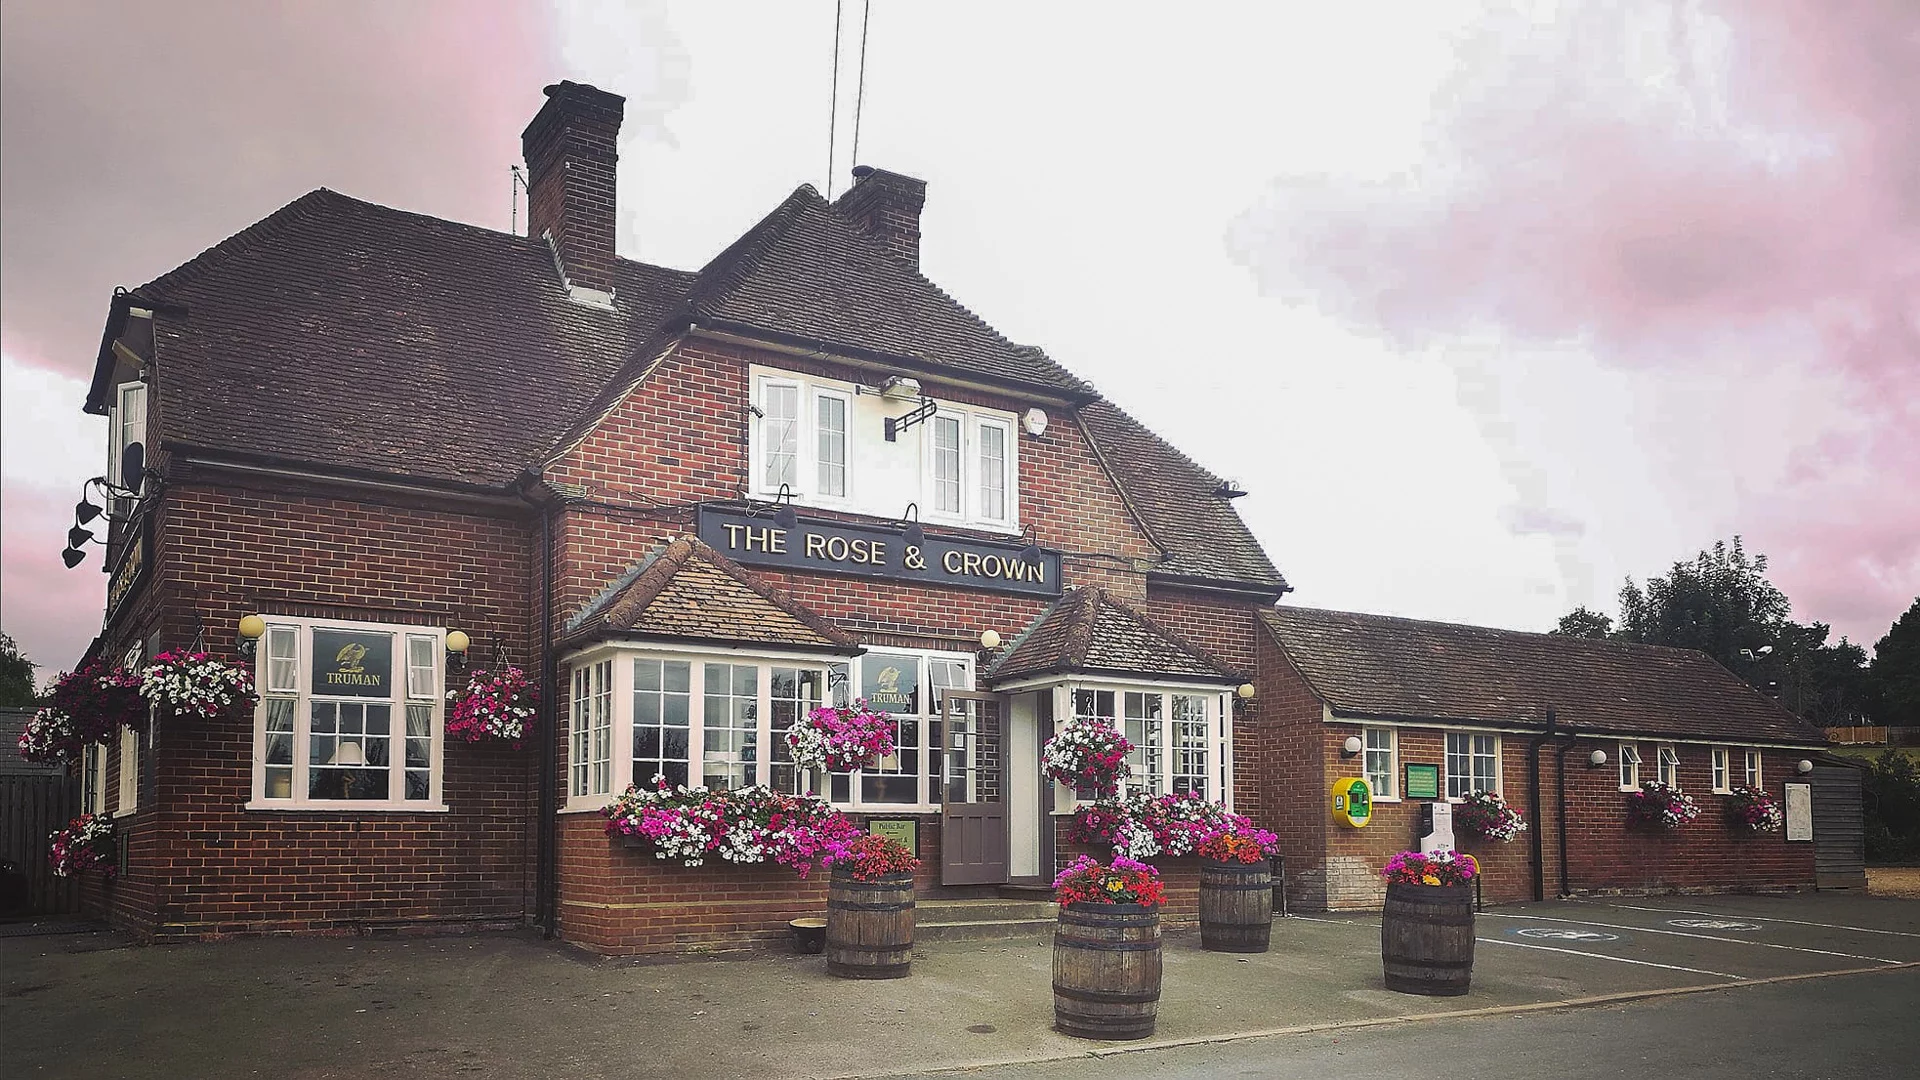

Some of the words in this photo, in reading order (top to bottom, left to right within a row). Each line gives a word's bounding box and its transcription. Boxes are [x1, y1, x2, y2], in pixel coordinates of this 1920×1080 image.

[722, 523, 787, 554] THE
[805, 533, 887, 566] ROSE
[904, 546, 927, 570] &
[943, 549, 1045, 583] CROWN
[326, 673, 381, 686] TRUMAN
[871, 692, 910, 704] TRUMAN
